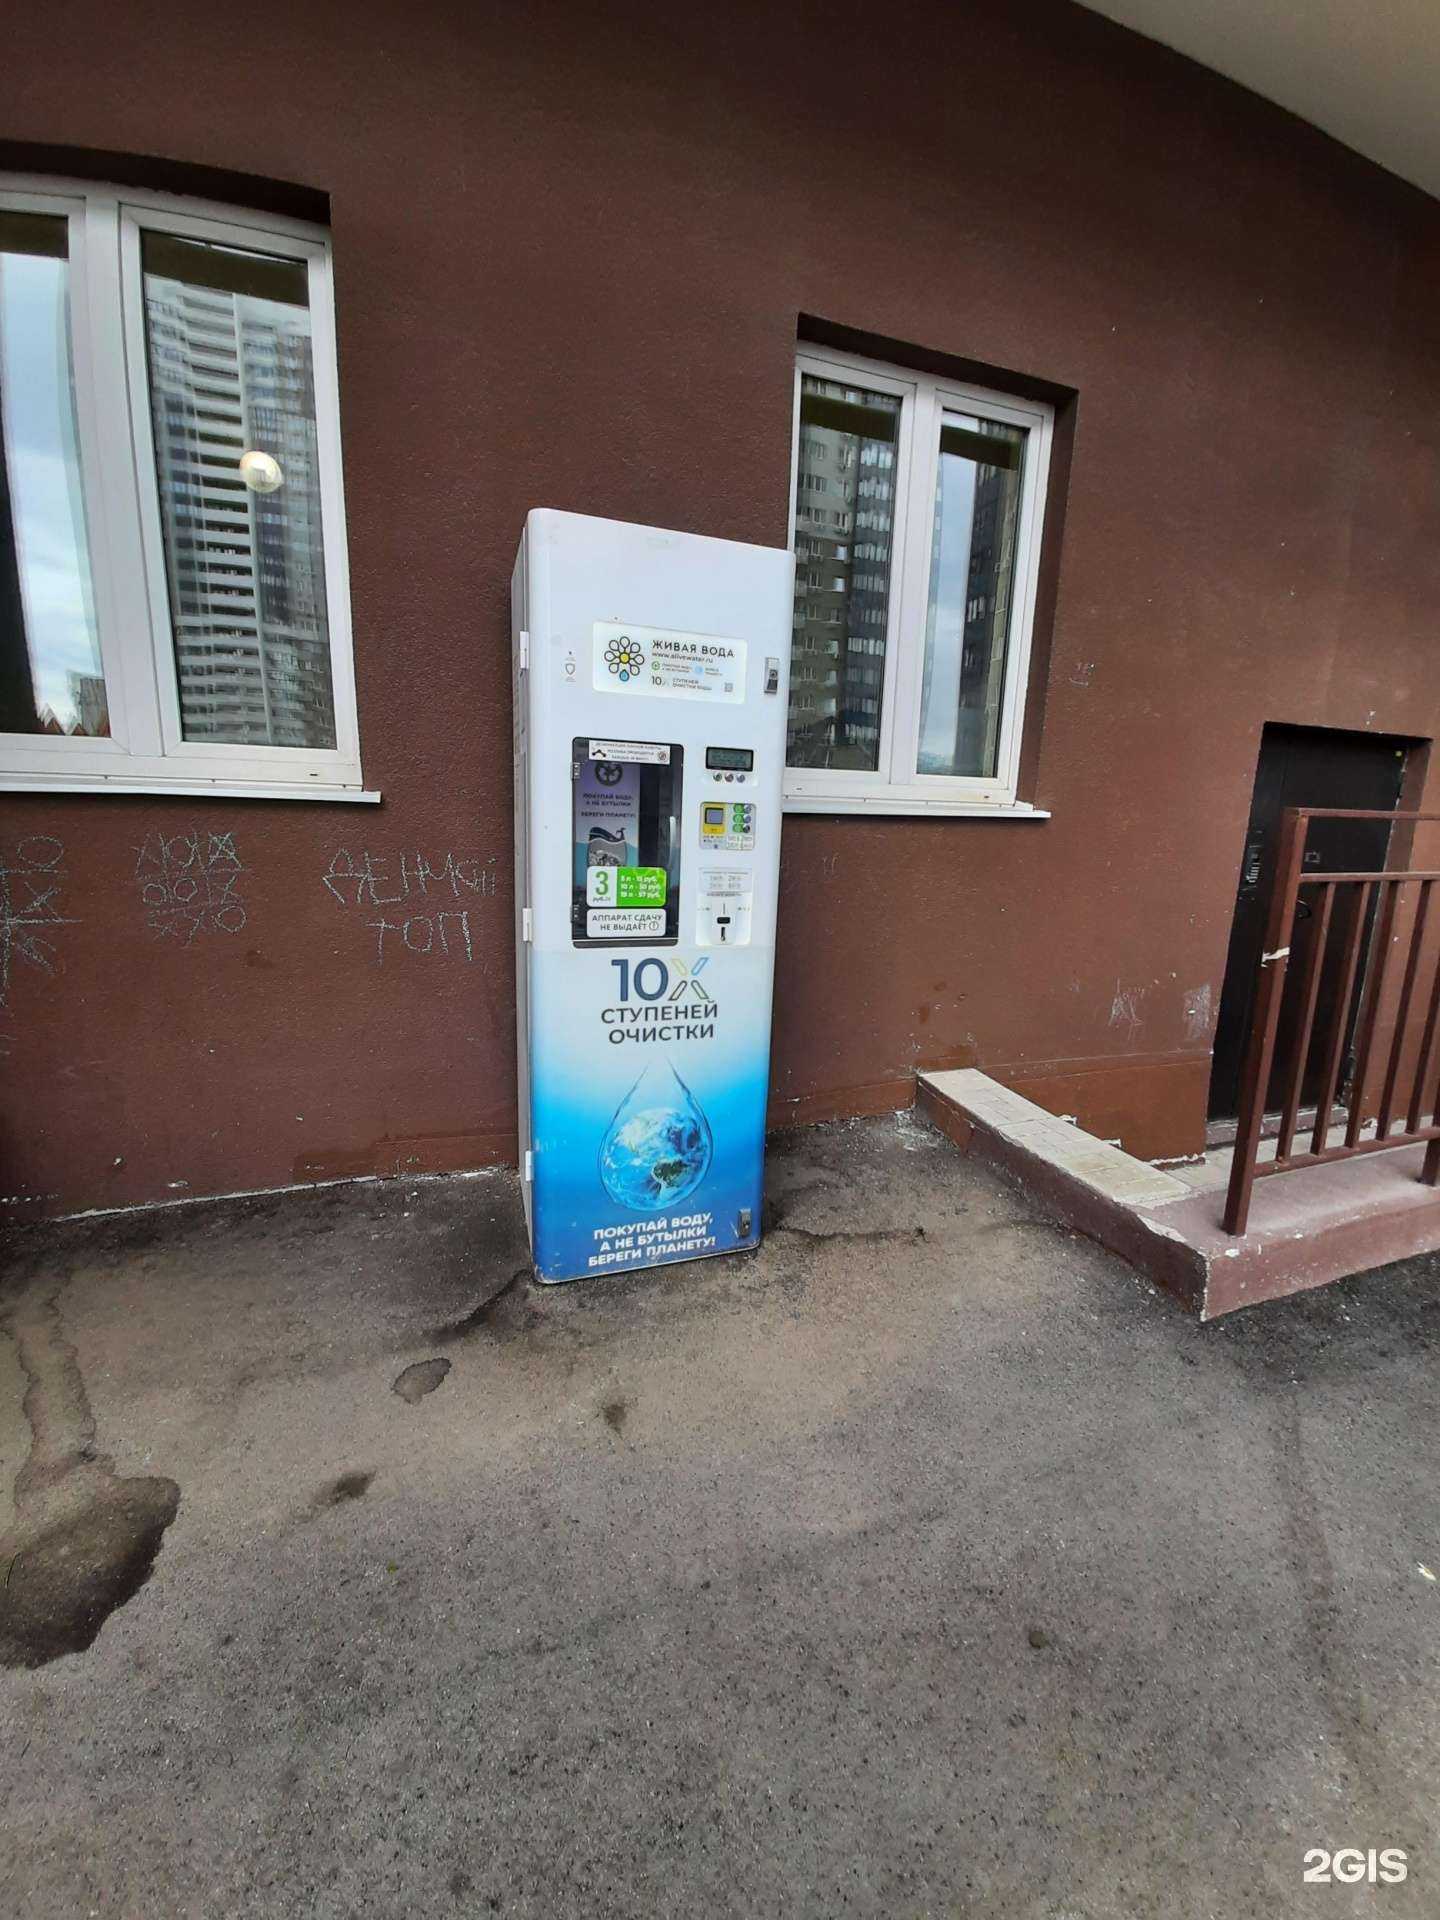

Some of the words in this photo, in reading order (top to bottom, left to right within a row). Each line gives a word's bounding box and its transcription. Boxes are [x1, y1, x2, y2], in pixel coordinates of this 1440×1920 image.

[652, 639, 697, 654] ЖИВАЯ
[701, 646, 735, 658] ВОДА
[594, 871, 609, 895] 3
[592, 914, 632, 922] АППАРАТ
[634, 914, 662, 922] СДАЧУ
[600, 923, 611, 931] НЕ
[366, 910, 473, 966] ТОП
[600, 1000, 718, 1024] СТУПЕНЕЙ
[608, 1023, 714, 1045] ОЧИСТКИ
[593, 1216, 668, 1240] ПОКУПАЙ
[671, 1212, 714, 1227] ВОДУ,
[599, 1242, 612, 1252] А
[614, 1237, 635, 1249] НЕ
[637, 1225, 707, 1245] БУТЫЛКИ
[588, 1249, 642, 1267] БЕРЕГИ
[646, 1237, 716, 1257] ПЛАНЕТУ!
